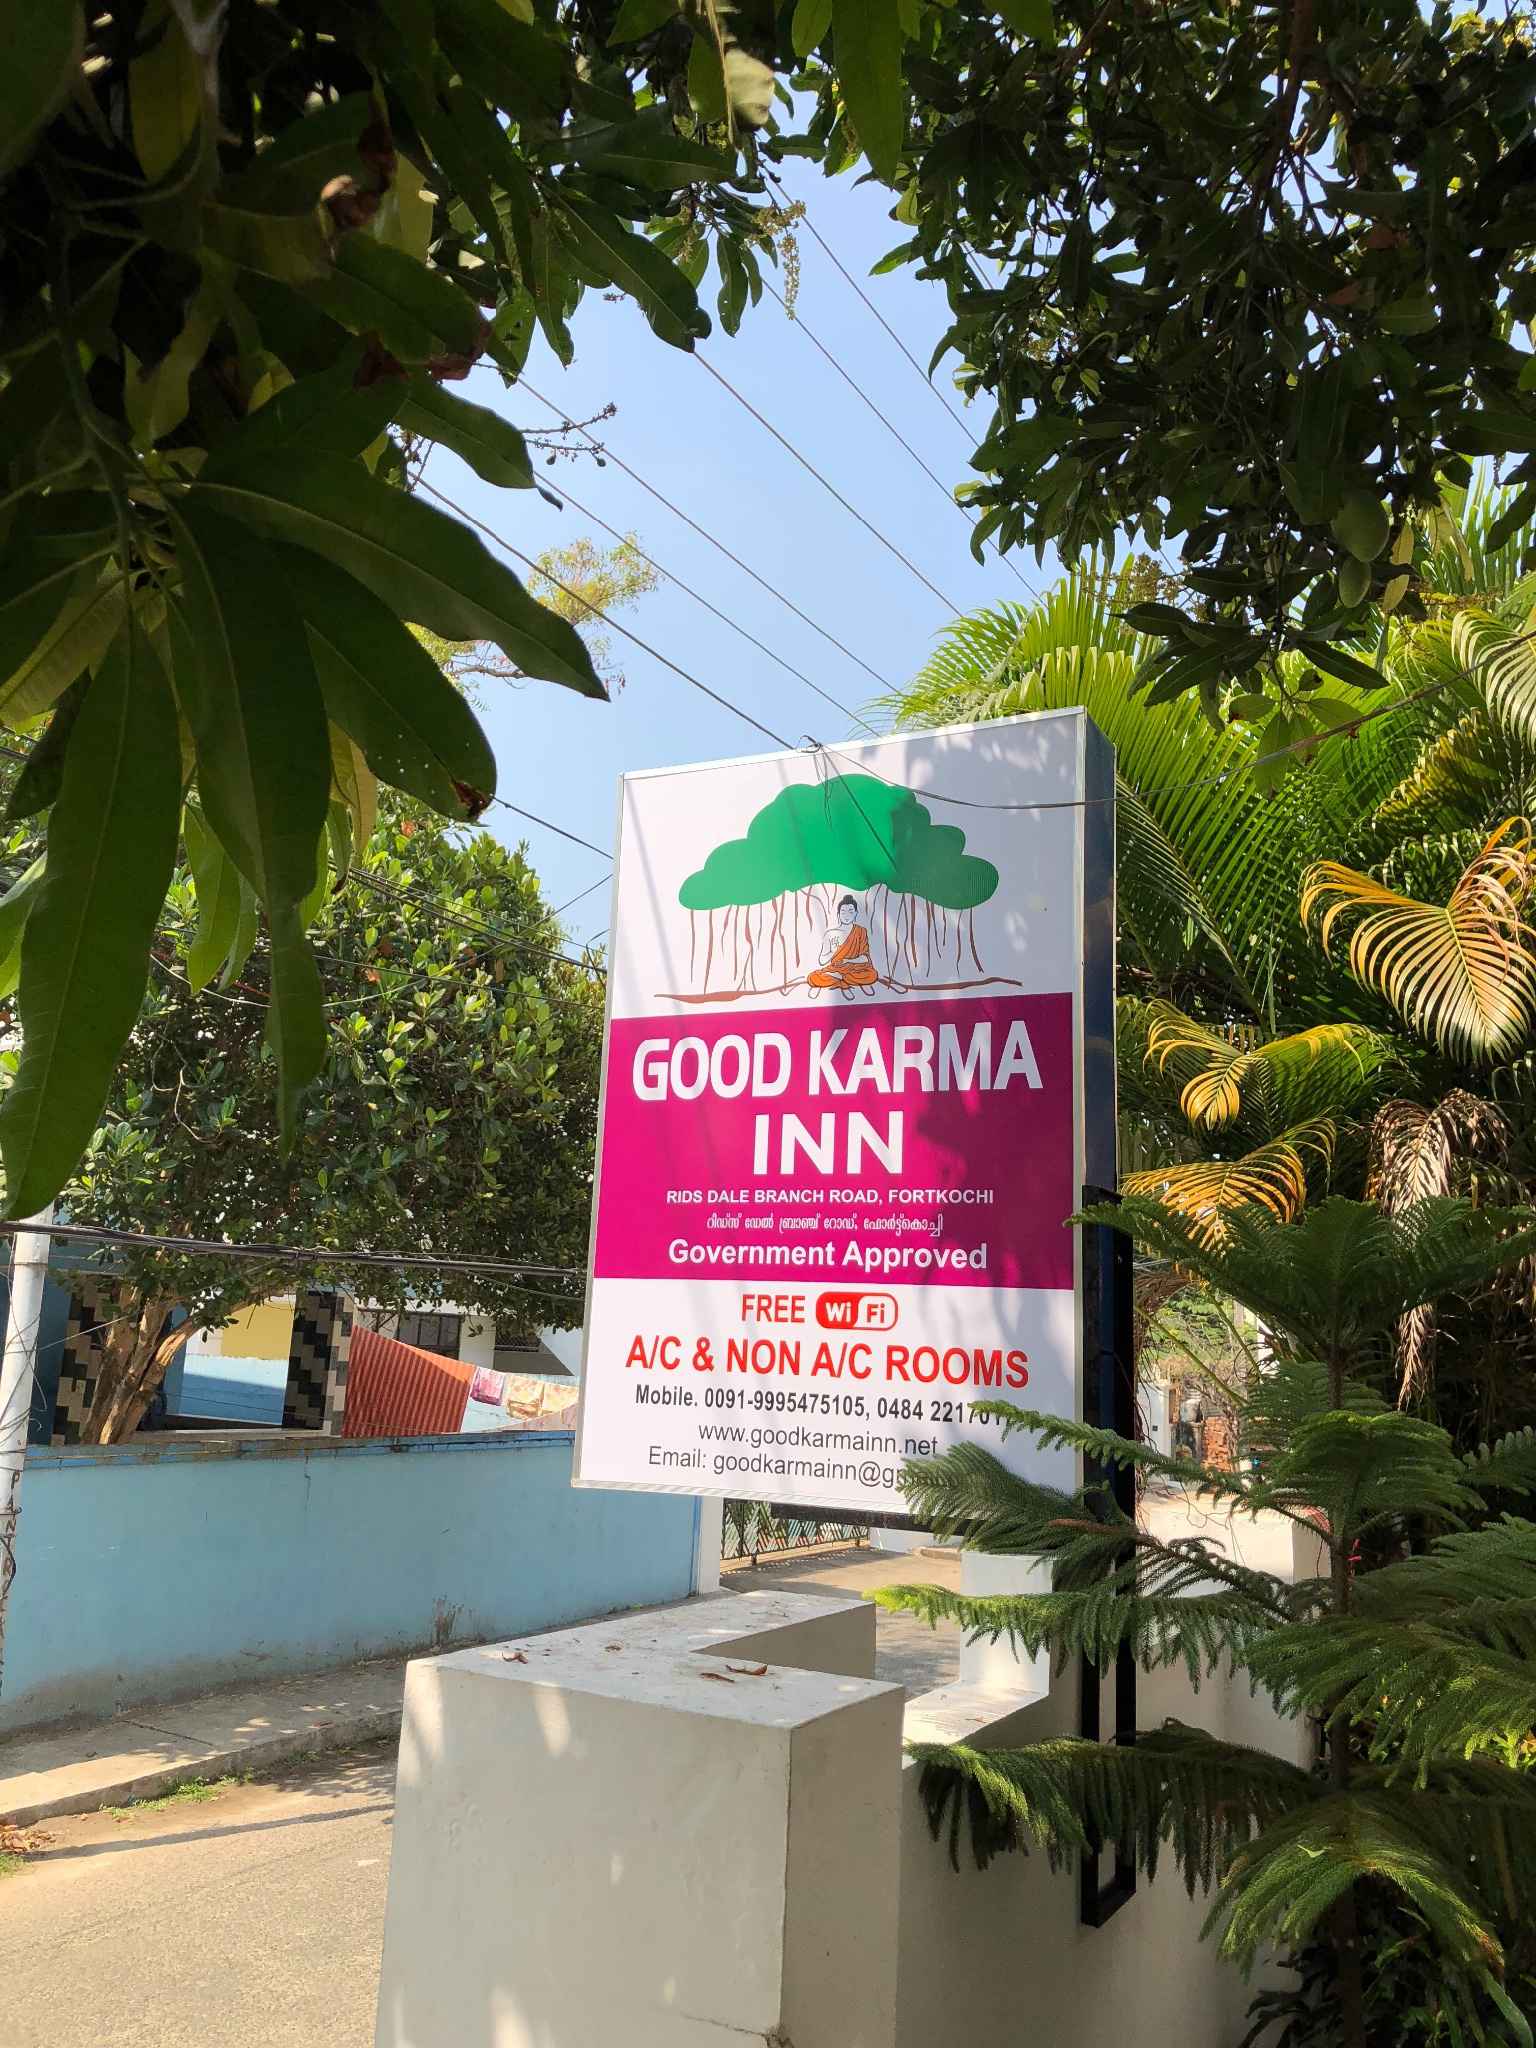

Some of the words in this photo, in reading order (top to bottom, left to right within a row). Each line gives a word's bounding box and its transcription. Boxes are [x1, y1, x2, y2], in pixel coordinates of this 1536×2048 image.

[632, 1031, 792, 1101] GOOD
[808, 1020, 1043, 1096] KARMA
[753, 1111, 904, 1175] INN
[666, 1190, 703, 1205] RIDS
[707, 1190, 749, 1204] DALE
[754, 1189, 824, 1203] BRANCH
[829, 1189, 883, 1206] ROAD,
[888, 1189, 994, 1204] FORTKOCHI
[668, 1238, 835, 1267] Government
[841, 1240, 987, 1273] Approved
[741, 1294, 806, 1323] FREE
[625, 1335, 681, 1370] A/C
[692, 1336, 715, 1372] &
[726, 1338, 801, 1376] NON
[810, 1342, 873, 1380] A/C
[885, 1344, 1029, 1389] ROOMS
[635, 1384, 698, 1407] Mobile.
[704, 1386, 870, 1421] 0091-9995475105,
[877, 1397, 924, 1420] 0484
[698, 1424, 938, 1456] www.goodkarmainn.net
[649, 1446, 706, 1469] Email:
[713, 1453, 902, 1489] goodkarmainn@g
